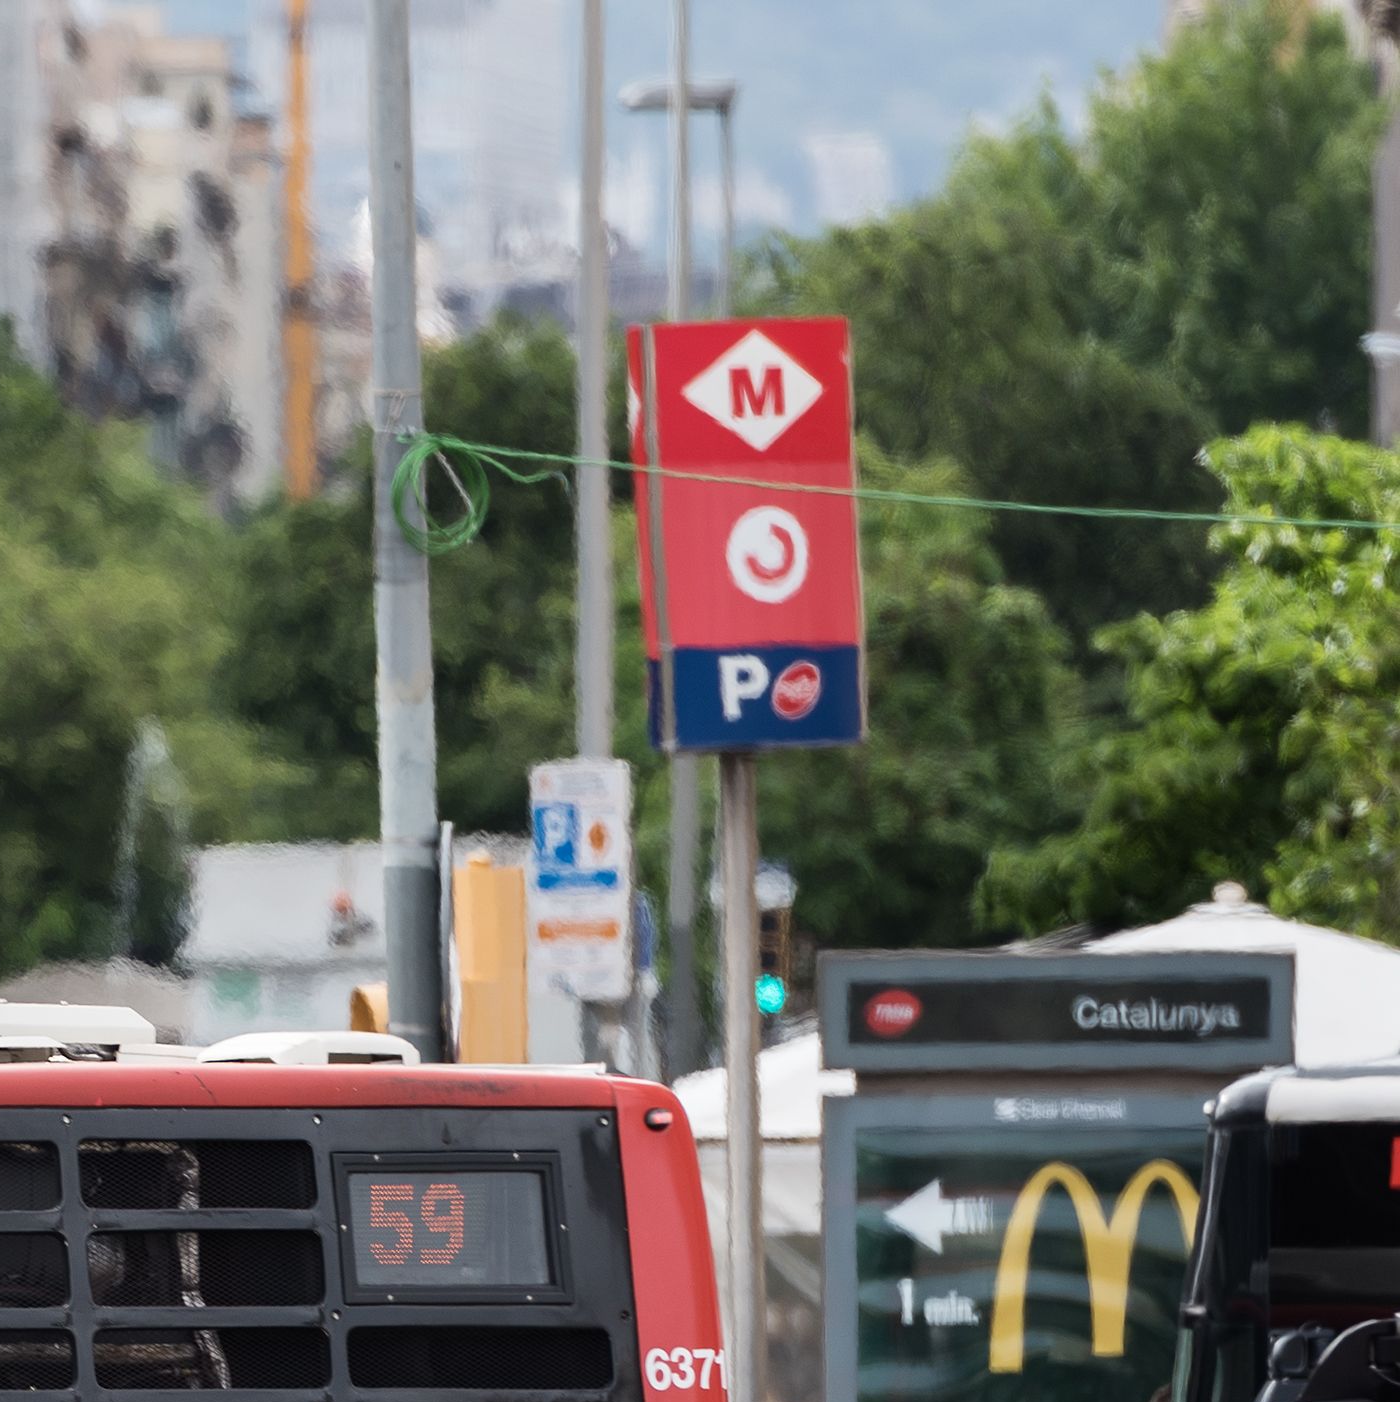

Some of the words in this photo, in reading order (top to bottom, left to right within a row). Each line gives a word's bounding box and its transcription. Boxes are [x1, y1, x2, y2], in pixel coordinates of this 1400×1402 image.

[729, 367, 785, 418] M
[718, 655, 769, 721] P
[1072, 995, 1241, 1036] Catalunya
[370, 1183, 464, 1264] 59
[898, 1278, 914, 1325] 1
[924, 1290, 979, 1326] min.
[644, 1347, 727, 1391] 6371
